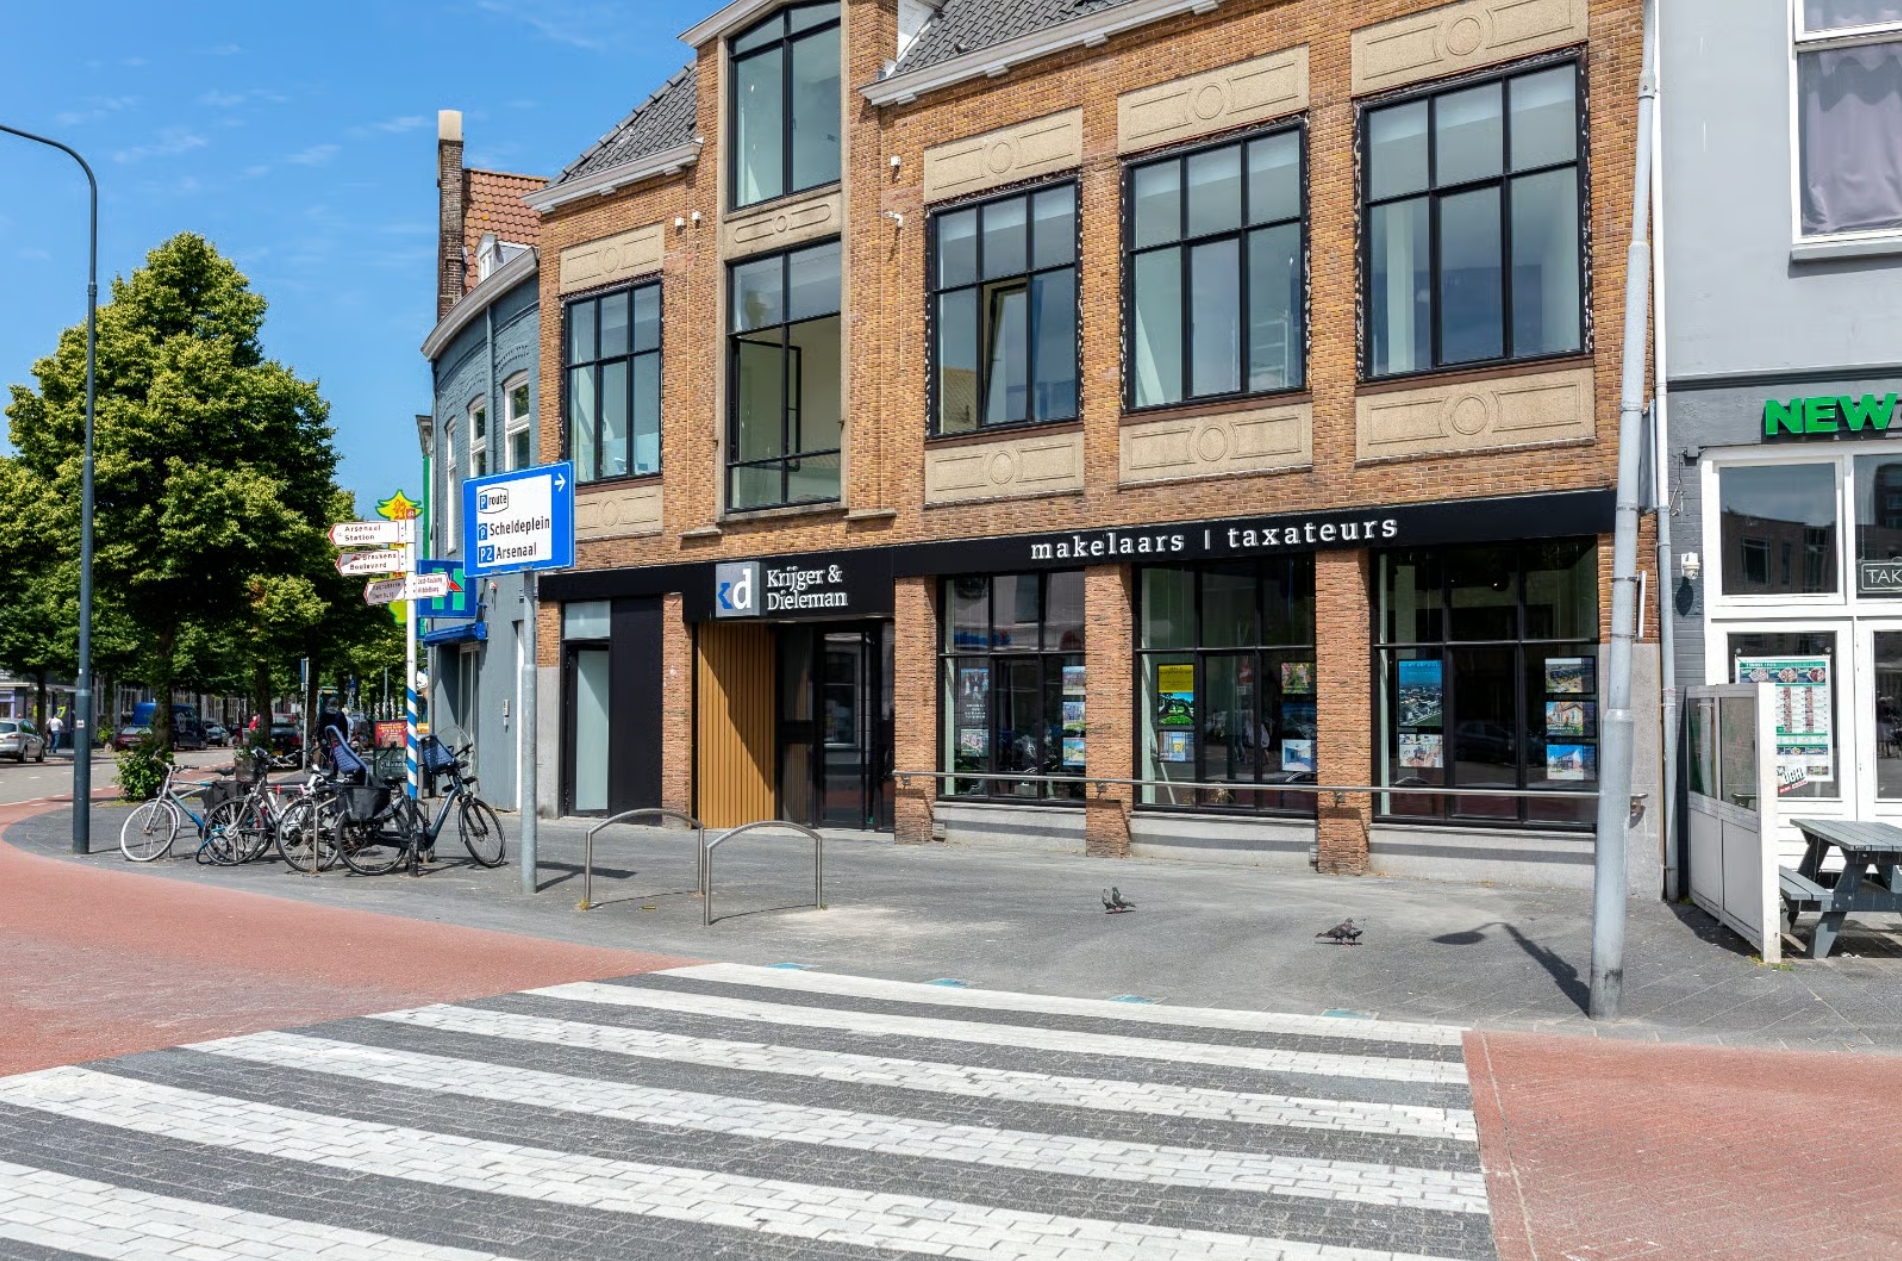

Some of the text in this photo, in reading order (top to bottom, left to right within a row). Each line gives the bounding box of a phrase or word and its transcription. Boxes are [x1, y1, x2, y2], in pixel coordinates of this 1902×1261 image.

[1765, 391, 1899, 436] NEW
[488, 494, 507, 506] route
[344, 524, 381, 532] Arsenaal
[489, 515, 550, 536] Scheldeplein
[344, 534, 375, 542] Station
[1031, 532, 1185, 560] makelaars
[1227, 519, 1398, 548] taxateurs
[480, 542, 537, 562] P2 Arsenaal
[349, 562, 387, 571] Boulevard
[766, 564, 843, 592] Krijger &
[767, 589, 849, 611] Dieleman
